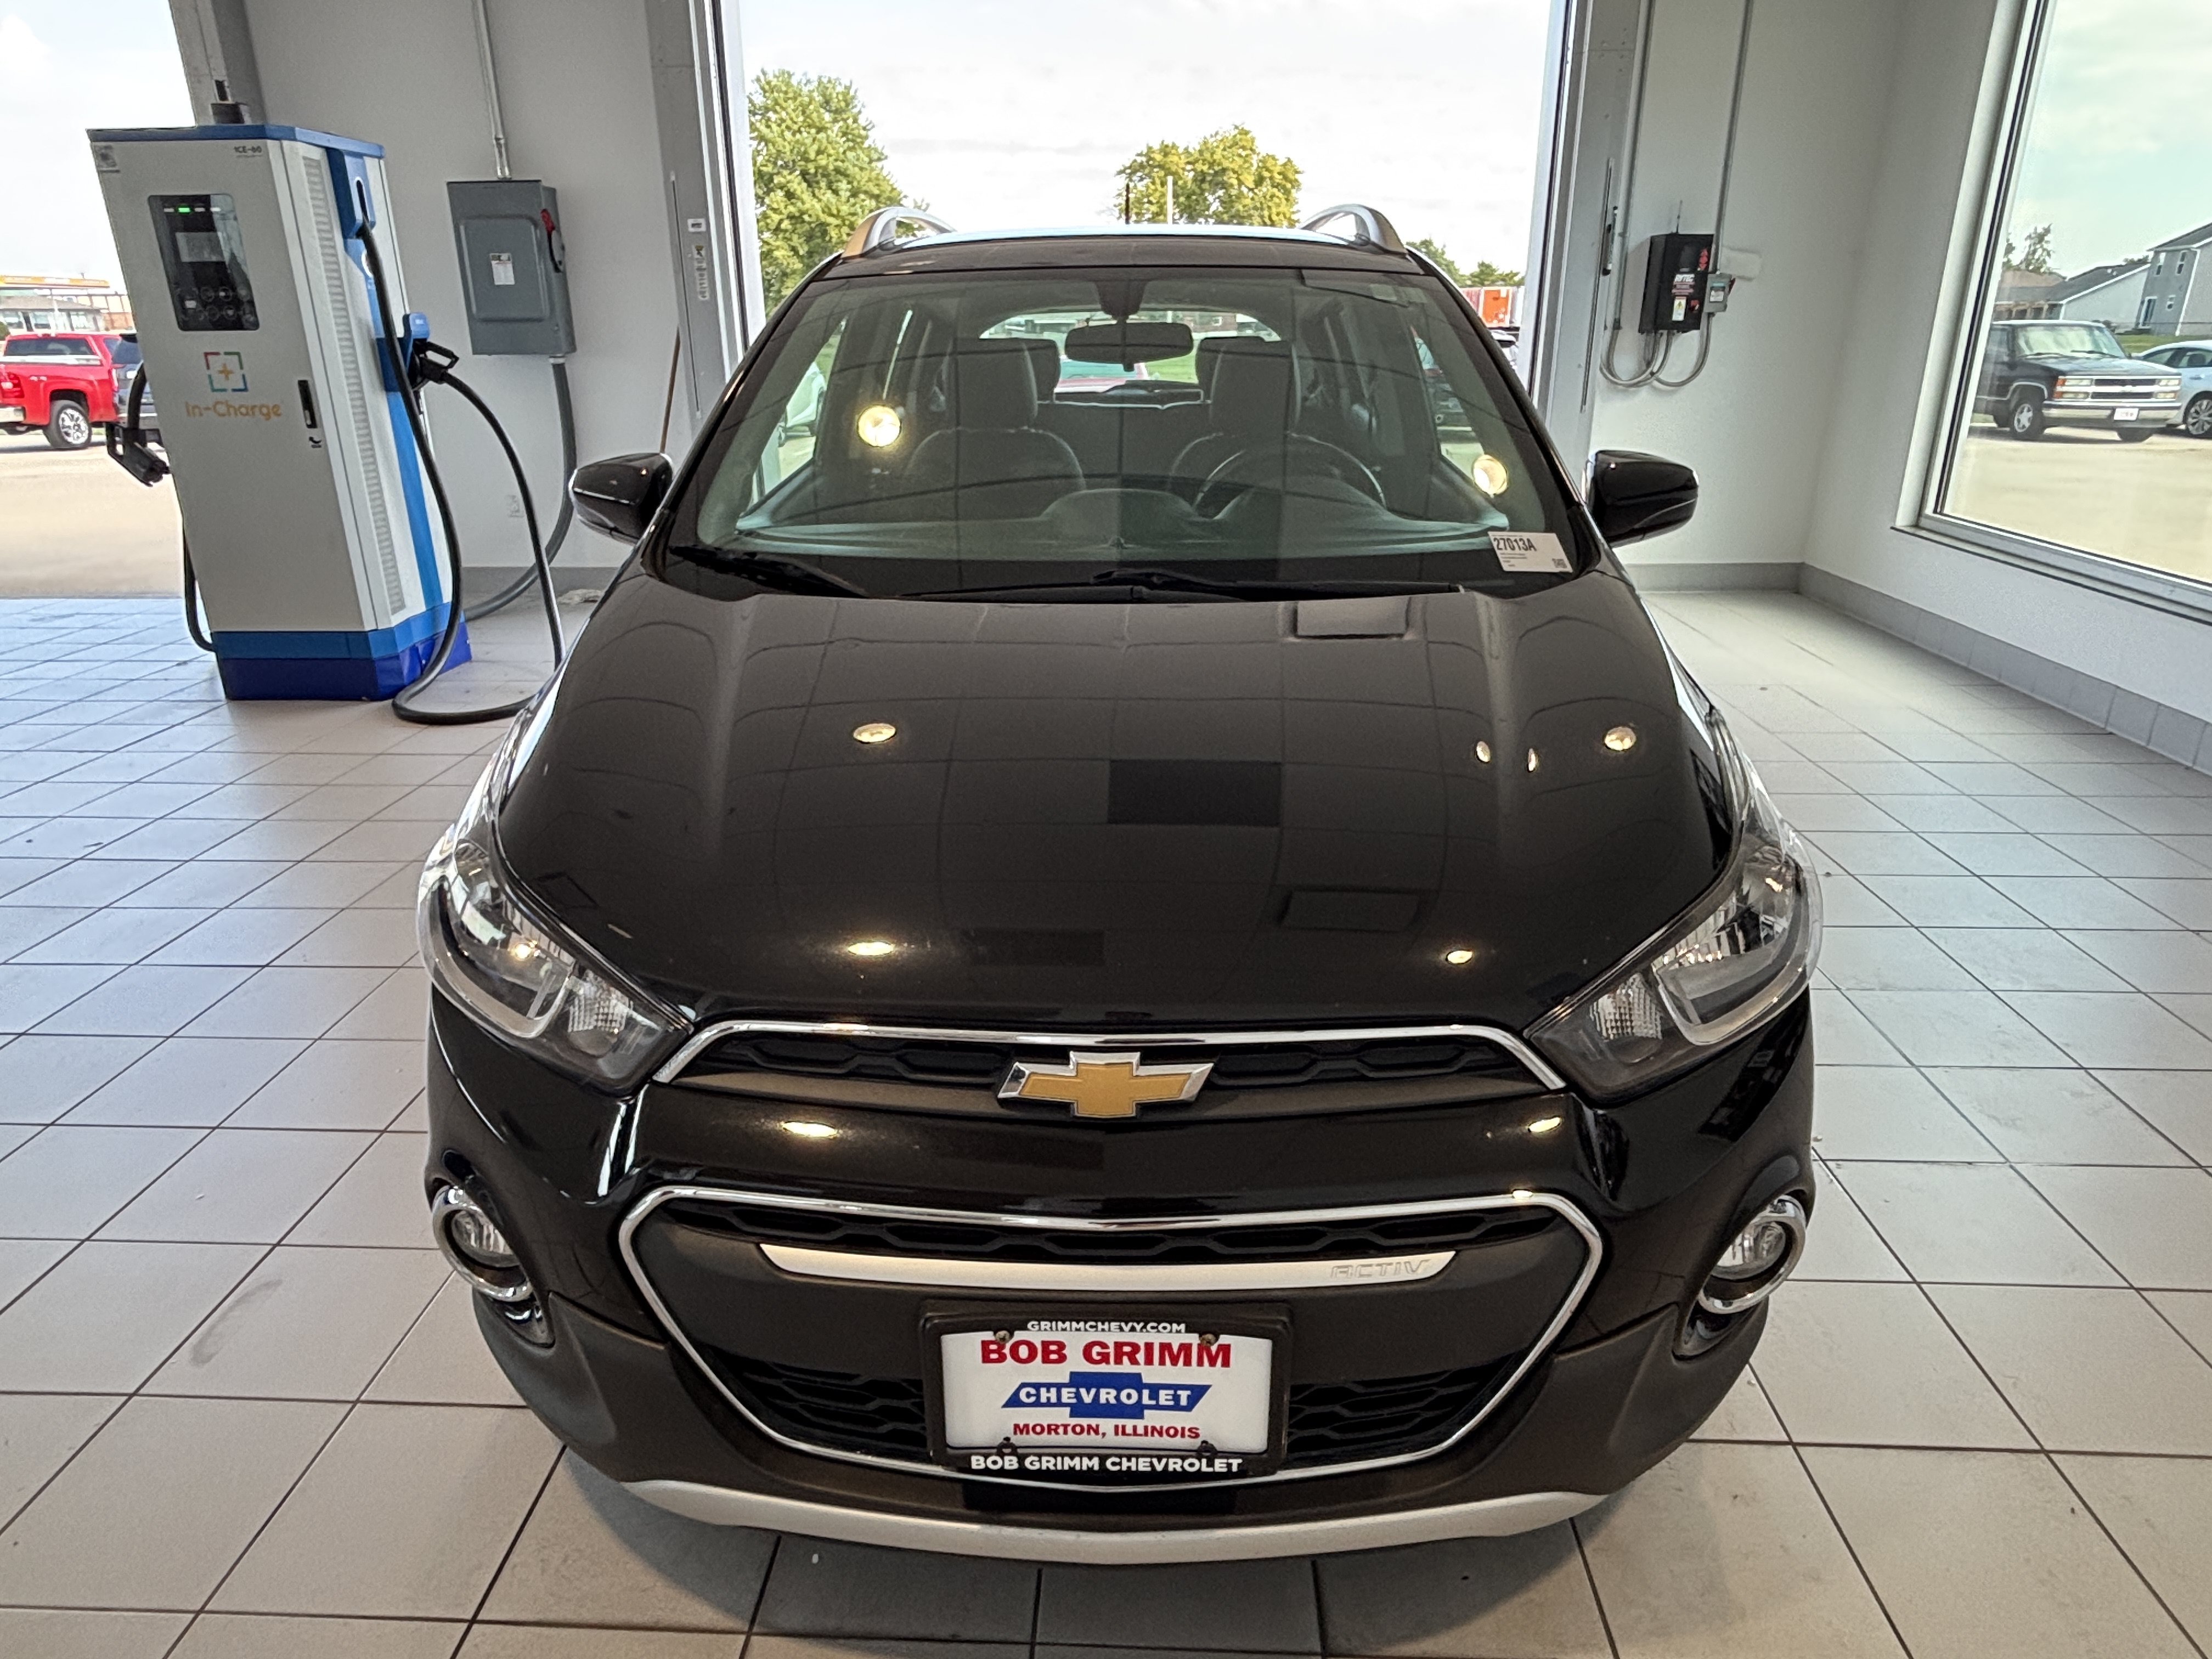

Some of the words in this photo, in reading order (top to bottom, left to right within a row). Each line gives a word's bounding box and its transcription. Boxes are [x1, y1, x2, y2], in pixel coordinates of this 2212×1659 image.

[184, 399, 281, 421] In-Charge
[1493, 538, 1537, 552] 27013A
[1330, 1259, 1431, 1279] ACTIV
[1026, 1320, 1186, 1334] GRIMMCHEVY.COM
[980, 1339, 1068, 1365] BOB
[1082, 1340, 1232, 1368] GRIMM
[1019, 1386, 1192, 1406] CHEVROLET
[1013, 1423, 1107, 1438] MORTON,
[1113, 1424, 1200, 1439] ILLINOIS
[970, 1455, 1019, 1470] BOB
[1024, 1455, 1101, 1471] GRIMM
[1105, 1456, 1243, 1472] CHEVROLET
